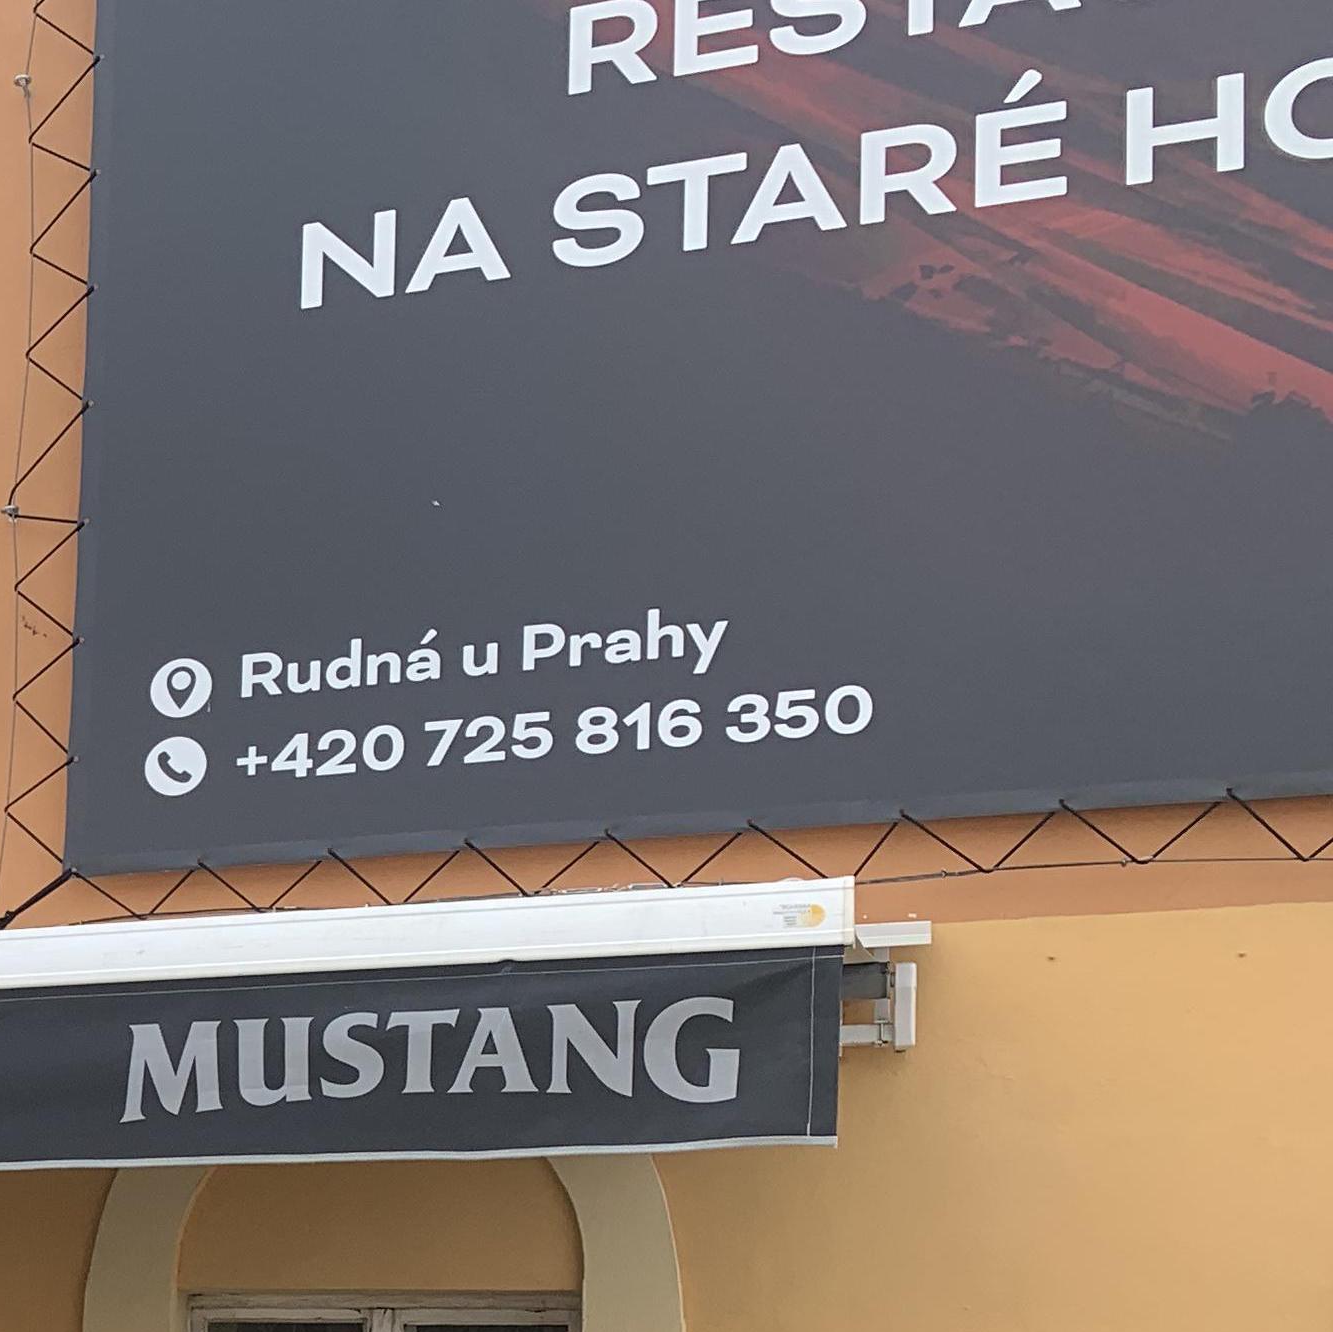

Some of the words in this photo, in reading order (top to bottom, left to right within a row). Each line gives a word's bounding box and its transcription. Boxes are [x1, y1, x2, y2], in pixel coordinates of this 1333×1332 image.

[567, 0, 1083, 96] RES
[300, 196, 512, 310] NA
[551, 68, 1069, 268] STARÉ
[239, 628, 442, 698] Rudná
[462, 642, 500, 677] u
[521, 607, 730, 675] Prahy
[235, 723, 406, 779] +420
[423, 710, 555, 767] 725
[574, 698, 704, 756] 816
[725, 684, 875, 744] 350
[117, 995, 742, 1124] MUSTANG
